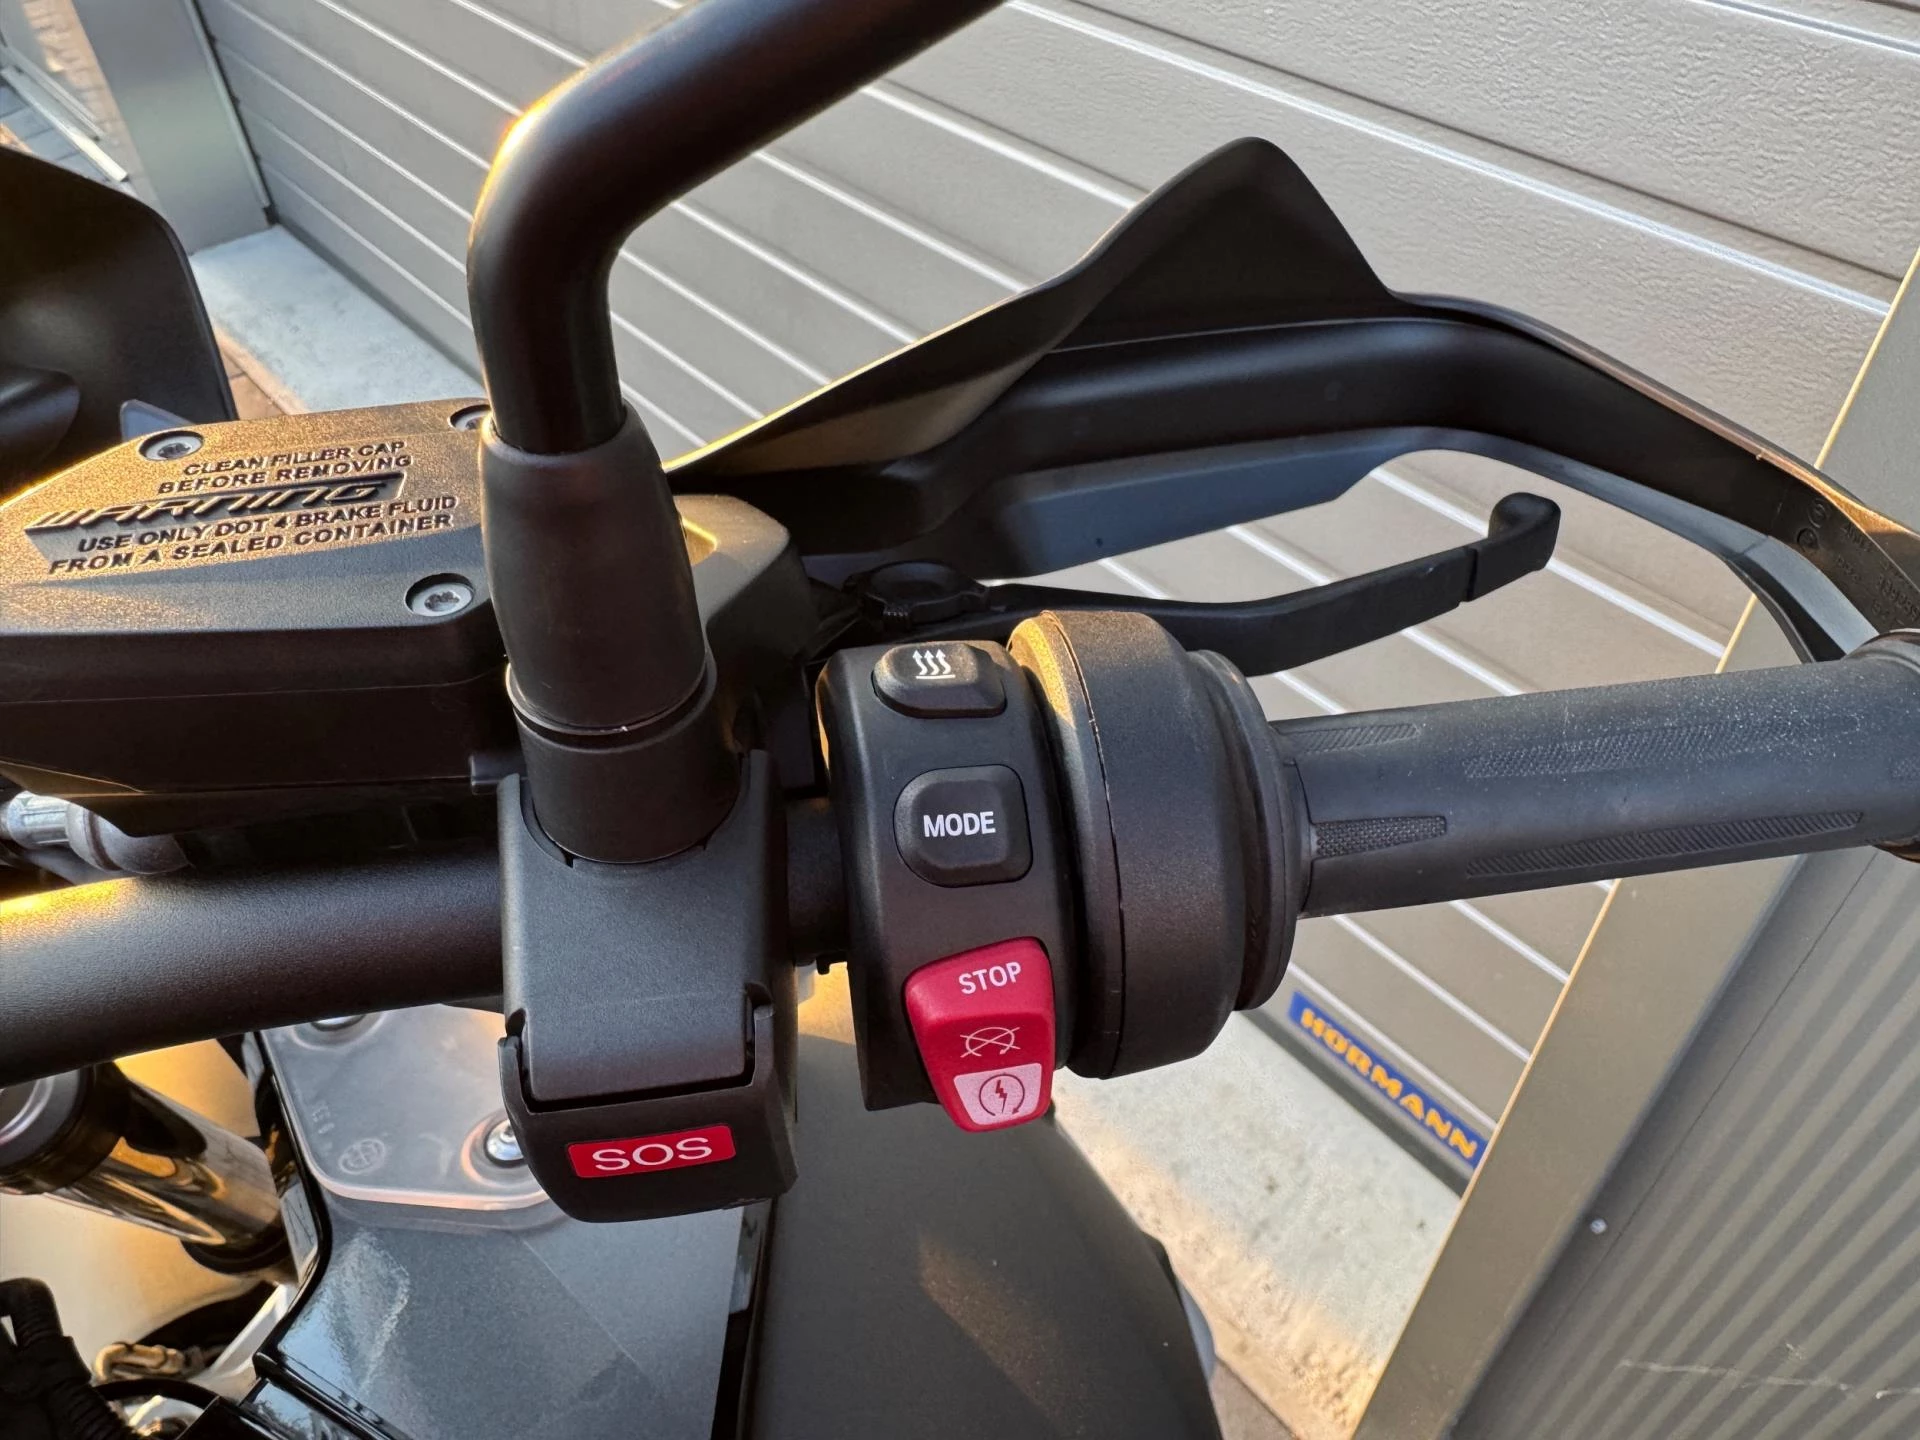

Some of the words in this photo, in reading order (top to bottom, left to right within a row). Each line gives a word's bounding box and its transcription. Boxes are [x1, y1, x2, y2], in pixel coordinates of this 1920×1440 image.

[158, 472, 267, 494] BEFORE
[276, 455, 413, 481] REMOVING
[183, 456, 269, 476] CLEAN
[270, 447, 350, 468] FILLER
[358, 441, 406, 457] CAP
[24, 481, 386, 533] WARNING
[78, 534, 133, 553] USE
[139, 524, 209, 546] ONLY
[214, 517, 269, 537] DOT
[274, 514, 289, 529] 4
[294, 504, 382, 527] BRAKE
[388, 496, 459, 516] FLUID
[49, 553, 134, 575] FROM
[140, 550, 161, 565] A
[171, 534, 284, 560] SEALED
[294, 514, 453, 546] CONTAINER
[923, 811, 996, 838] MODE
[958, 961, 1022, 995] STOP
[591, 1136, 713, 1171] SOS
